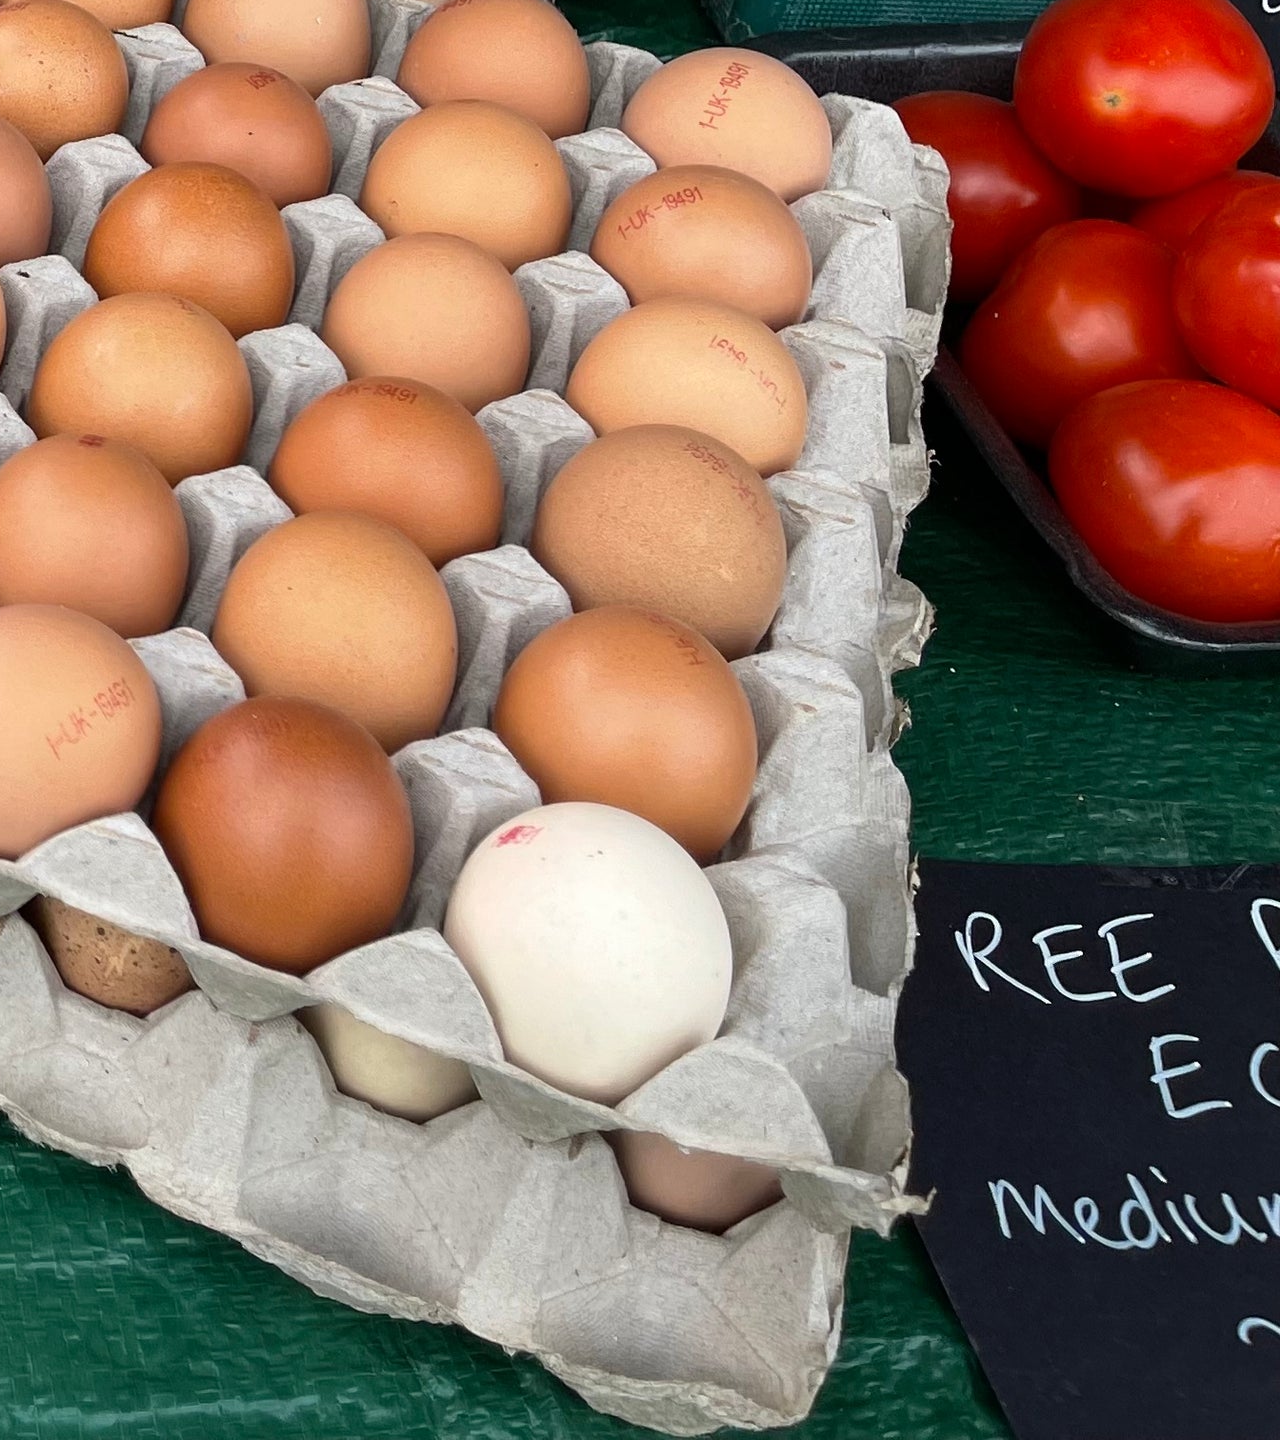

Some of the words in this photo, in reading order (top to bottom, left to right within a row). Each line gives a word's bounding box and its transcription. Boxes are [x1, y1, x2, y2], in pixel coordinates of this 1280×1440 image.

[697, 60, 752, 132] 1-UK-19491
[616, 185, 705, 242] 1-UK-19491
[954, 911, 1177, 1006] REE
